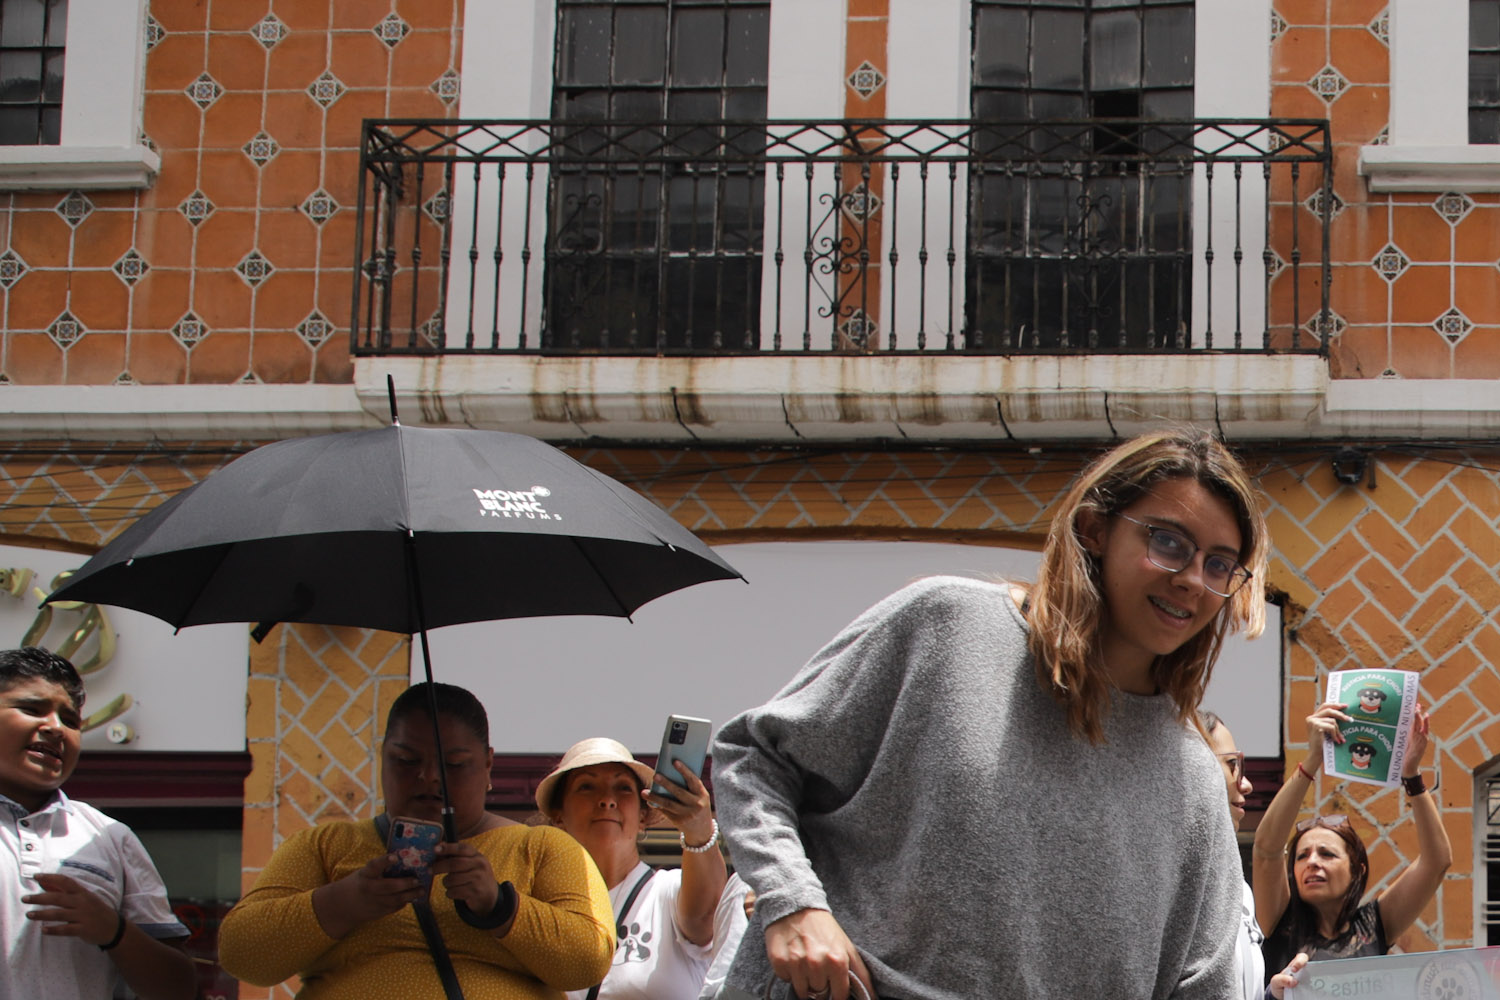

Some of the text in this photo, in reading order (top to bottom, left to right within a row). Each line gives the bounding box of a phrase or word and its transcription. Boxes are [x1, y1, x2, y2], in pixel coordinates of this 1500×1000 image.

[473, 488, 537, 502] MONT
[480, 500, 546, 513] BLANC
[480, 509, 563, 521] PARFUMS
